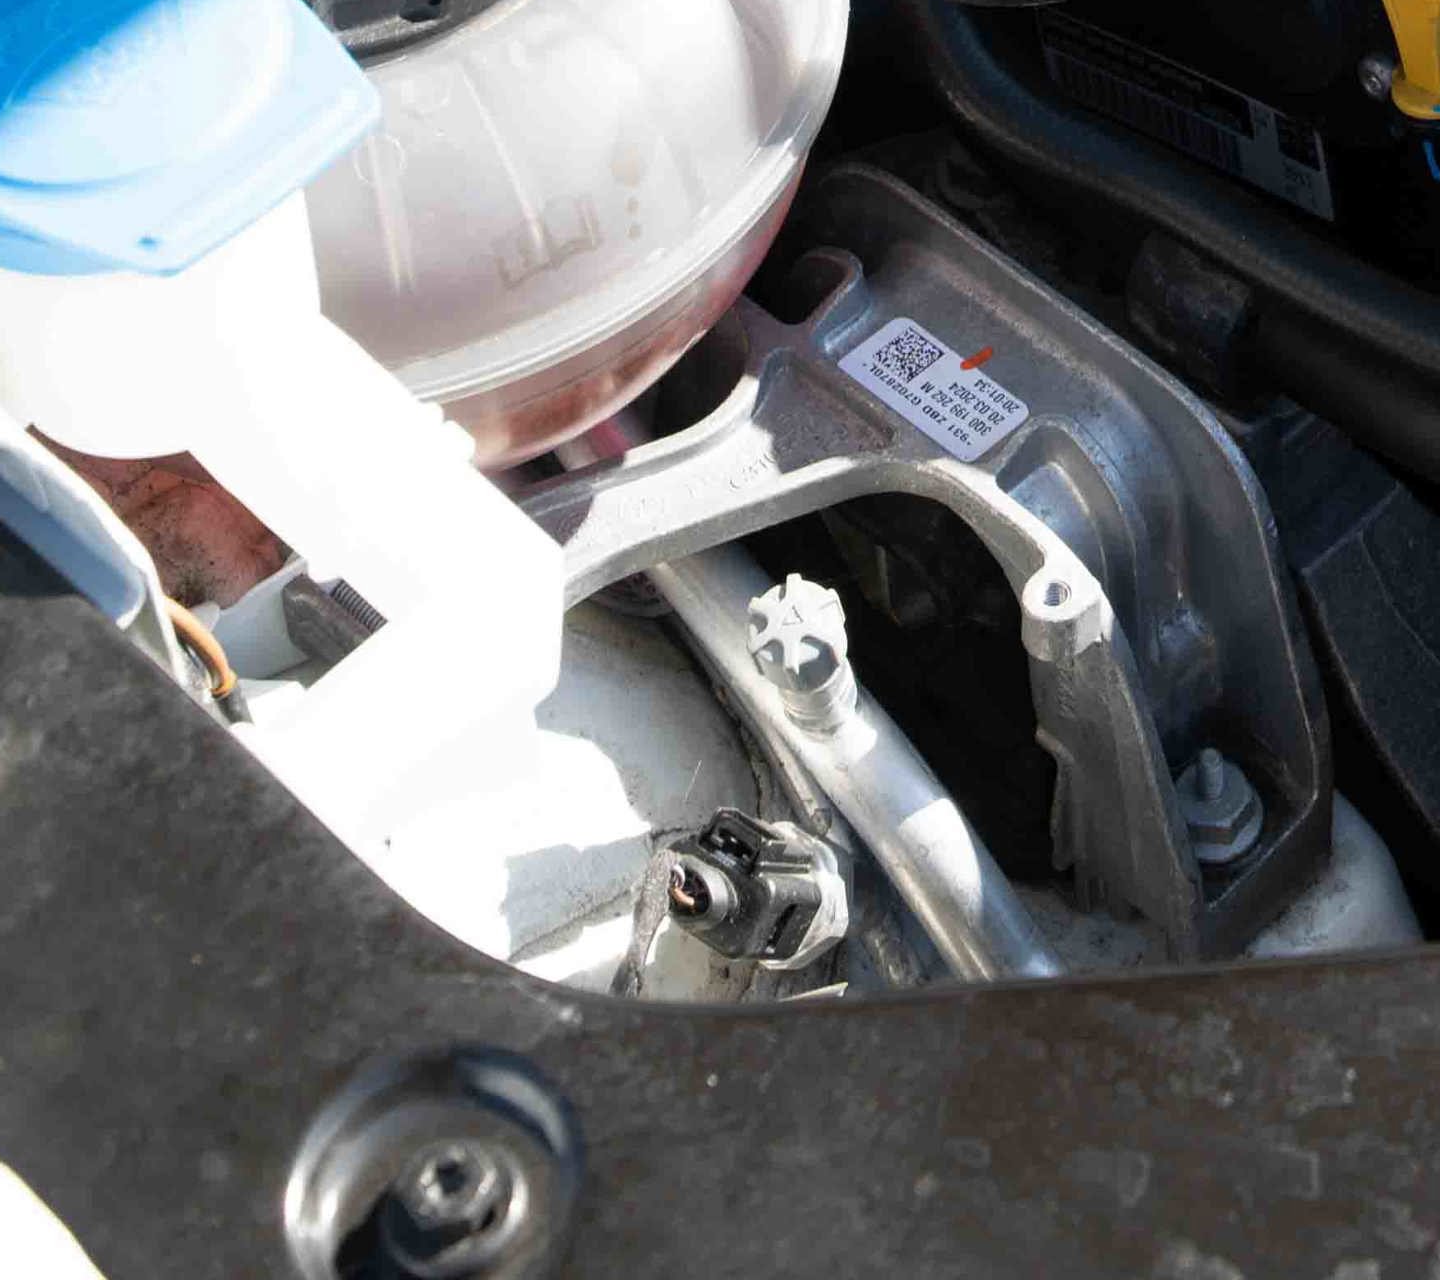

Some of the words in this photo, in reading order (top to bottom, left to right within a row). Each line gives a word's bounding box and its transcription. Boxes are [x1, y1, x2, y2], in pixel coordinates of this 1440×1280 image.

[920, 382, 931, 394] M
[948, 383, 1005, 425] 20.03.2024
[950, 404, 970, 420] 199
